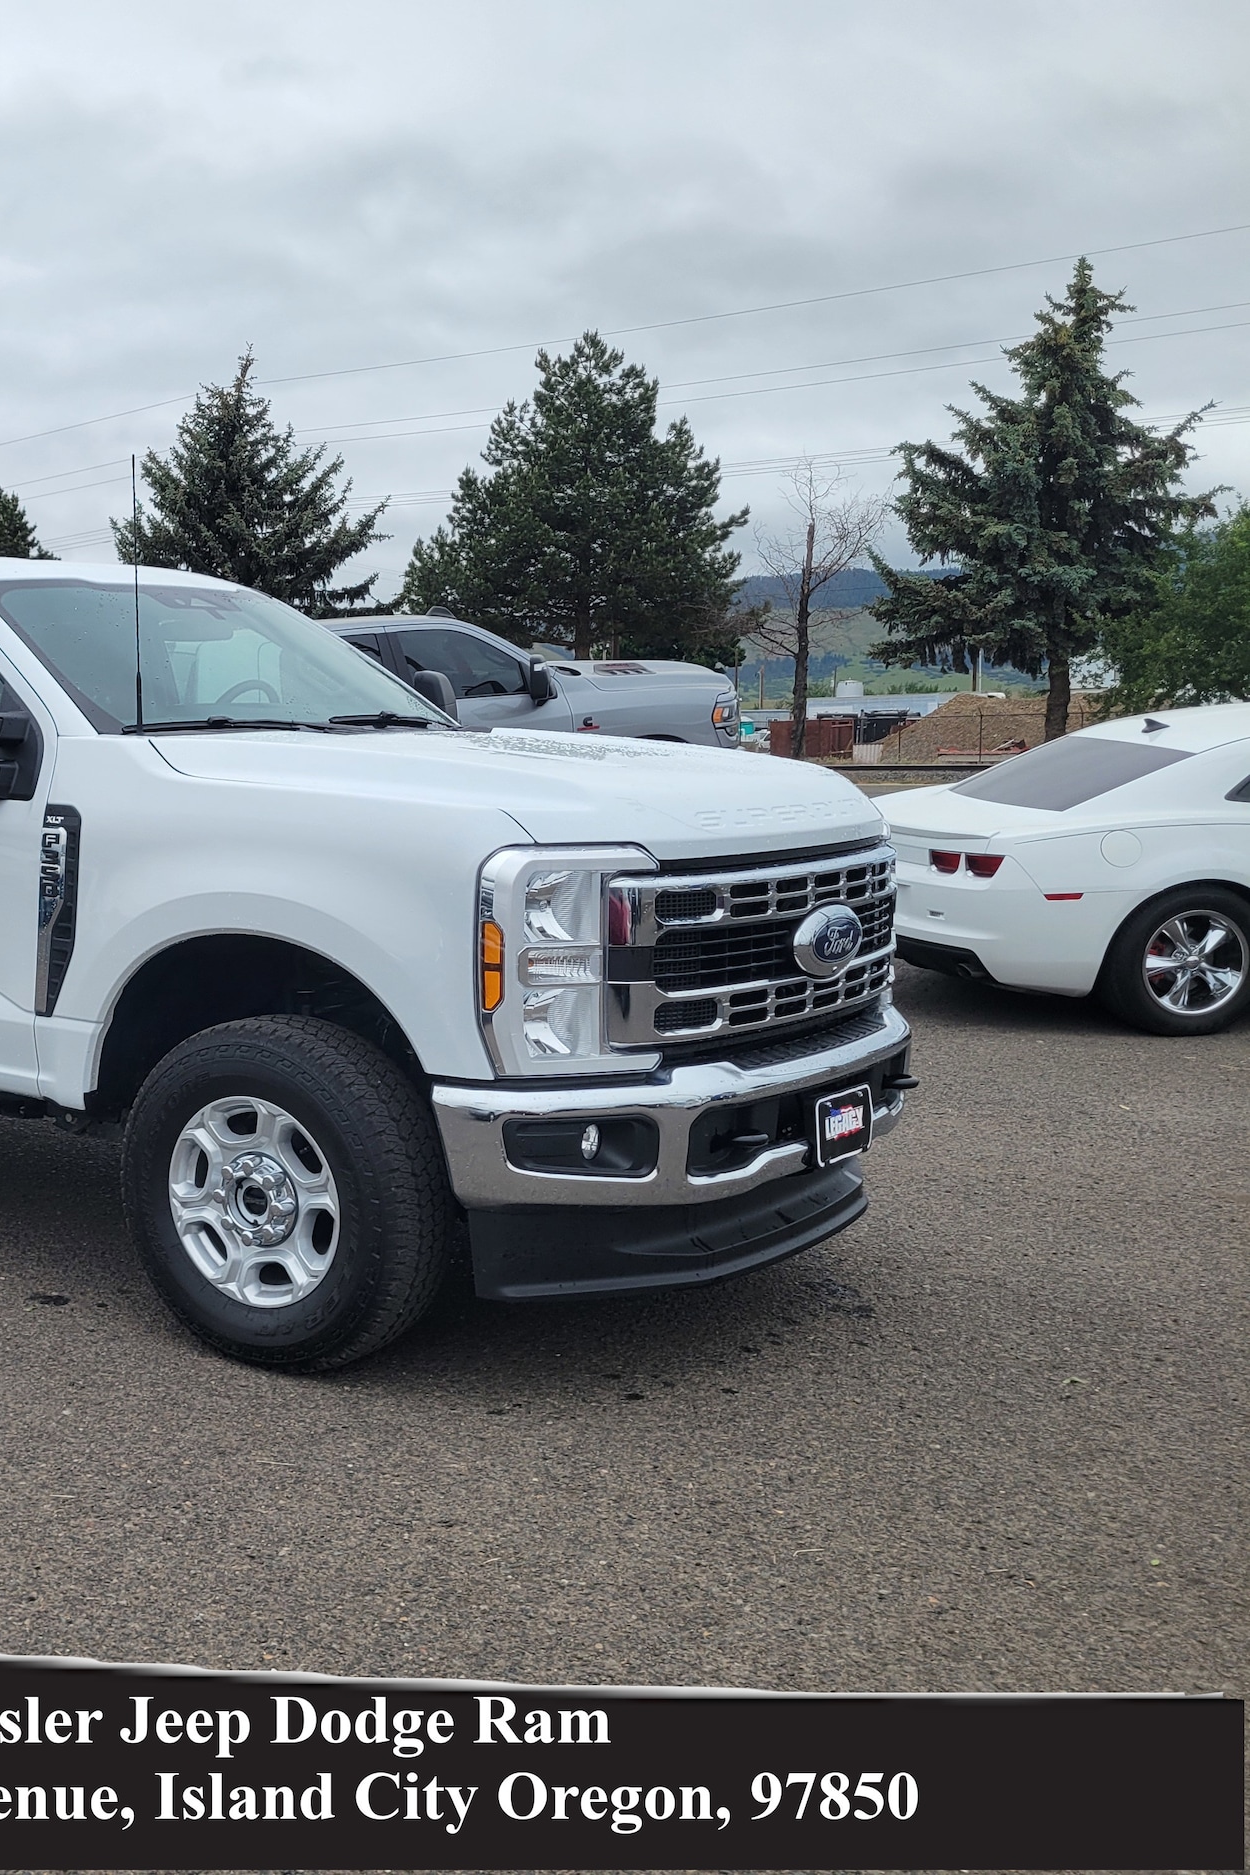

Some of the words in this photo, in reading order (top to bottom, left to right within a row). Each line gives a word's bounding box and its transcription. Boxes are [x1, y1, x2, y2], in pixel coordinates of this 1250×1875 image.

[46, 815, 65, 824] XLT
[823, 924, 854, 956] Ford
[825, 1106, 864, 1140] LEGACY
